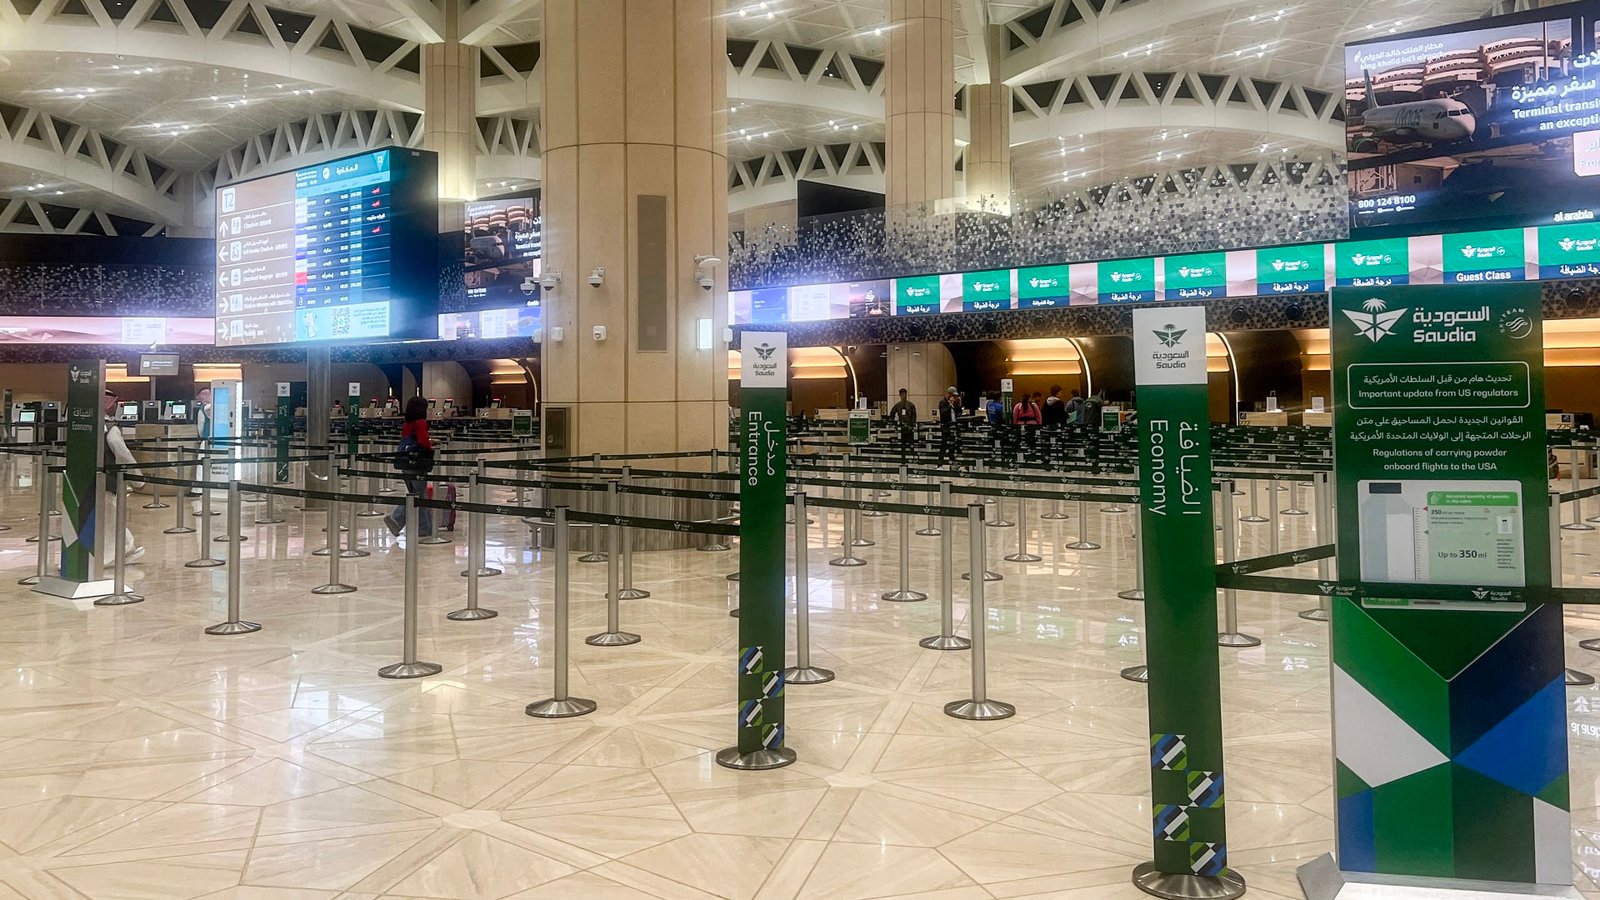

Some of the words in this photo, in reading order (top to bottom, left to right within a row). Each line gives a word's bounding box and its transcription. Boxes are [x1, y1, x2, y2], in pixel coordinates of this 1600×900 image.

[1560, 75, 1596, 97] سفر
[1512, 85, 1557, 103] مميزة
[1512, 103, 1563, 119] Terminal
[1565, 98, 1600, 112] transi
[1540, 121, 1554, 130] an
[1556, 113, 1600, 129] excepti
[1358, 199, 1374, 208] 800
[1376, 197, 1392, 206] 124
[1393, 195, 1416, 204] 8100
[1456, 272, 1483, 282] Guest
[1485, 271, 1511, 280] Class
[1413, 306, 1490, 327] السعودية
[1413, 327, 1476, 343] Saudia
[1152, 350, 1189, 362] السعودية
[1156, 361, 1186, 369] Saudia
[1364, 373, 1398, 385] الأمريكية
[1400, 375, 1435, 383] السلطات
[1436, 375, 1453, 385] قبل
[1454, 376, 1467, 384] من
[1469, 375, 1484, 385] هام
[1485, 375, 1512, 384] تحديث
[1358, 390, 1401, 399] Important
[1403, 389, 1433, 399] update
[1435, 389, 1456, 397] from
[1458, 389, 1471, 397] US
[1473, 388, 1519, 399] regulators
[1357, 417, 1374, 426] متن
[1375, 416, 1390, 427] على
[1391, 416, 1431, 426] المساحيق
[1433, 416, 1457, 426] لحمل
[1459, 416, 1488, 426] الجديدة
[1490, 416, 1523, 425] القوانين
[1350, 429, 1384, 441] الأمريكية
[1386, 431, 1418, 440] المتحدة
[1420, 431, 1449, 441] الولايات
[1450, 431, 1464, 442] إلى
[1465, 431, 1499, 441] المتجهة
[1500, 431, 1532, 441] الرحلات
[748, 411, 762, 486] Entrance
[763, 421, 780, 476] مدخل
[1372, 448, 1423, 458] Regulations
[1424, 448, 1434, 456] of
[1435, 448, 1472, 458] carrying
[1473, 448, 1508, 458] powder
[1149, 419, 1168, 516] Economy
[1175, 421, 1201, 515] الضيافة
[1384, 462, 1420, 470] onboard
[1422, 462, 1449, 472] flights
[1461, 462, 1476, 470] the
[1477, 462, 1498, 470] USA
[1438, 551, 1448, 559] Up
[1459, 550, 1477, 558] 350
